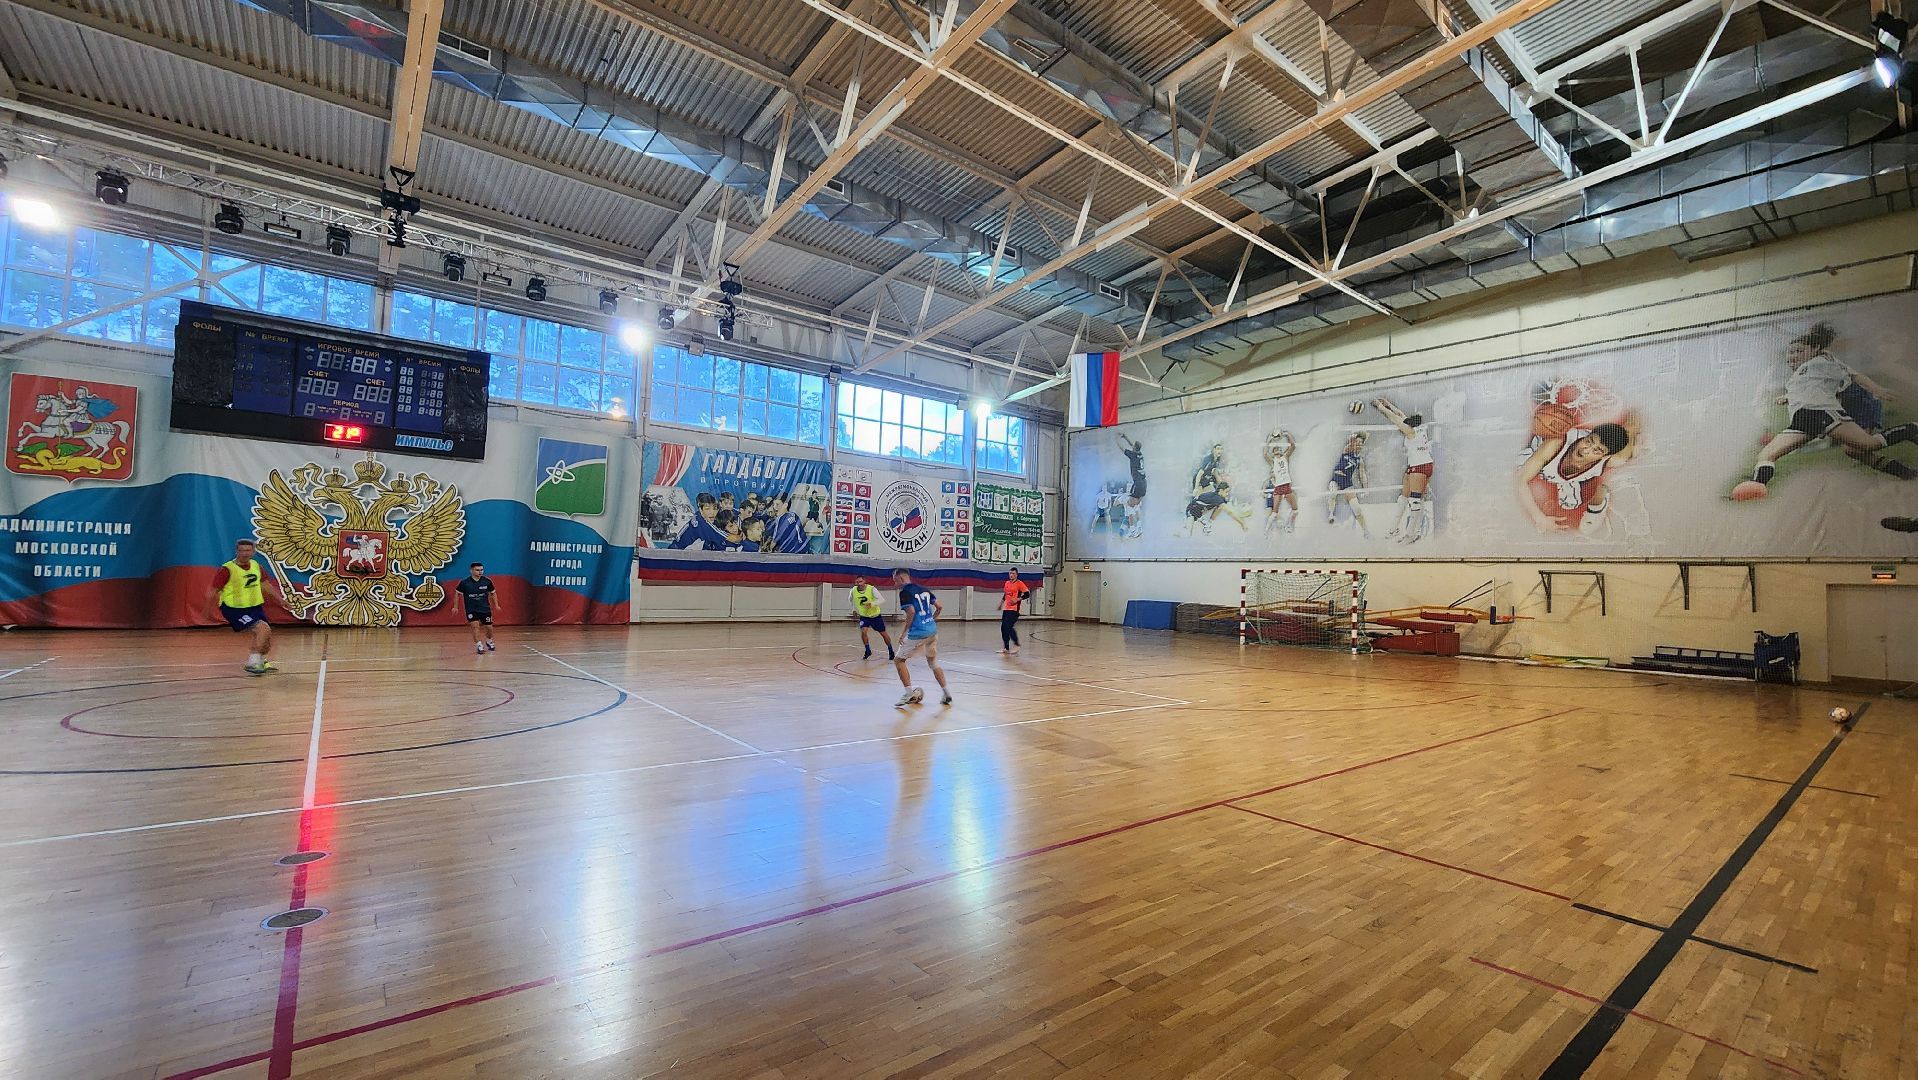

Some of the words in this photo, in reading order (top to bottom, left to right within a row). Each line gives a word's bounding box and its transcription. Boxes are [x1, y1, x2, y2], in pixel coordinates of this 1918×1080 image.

[192, 321, 221, 332] ФОЛЫ
[317, 343, 352, 354] ИГРОВОЕ
[355, 348, 380, 358] ВРЕМЯ
[307, 369, 329, 378] СЧЕТ
[365, 377, 386, 386] СЧЕТ
[333, 399, 360, 409] ПЕРИОД
[701, 452, 788, 480] ГАНДБОЛ
[714, 479, 785, 491] ПРОТВИНО
[0, 518, 132, 535] АДМИНИСТРАЦИЯ
[883, 528, 927, 553] ЭРИДАН
[15, 541, 117, 556] МОСКОВСКОЙ
[530, 541, 603, 554] АДМИНИСТРАЦИЯ
[550, 558, 582, 570] ГОРОДА
[34, 565, 102, 577] ОБЛАСТИ
[545, 575, 587, 586] ПРОТВИНО
[914, 592, 930, 615] 17
